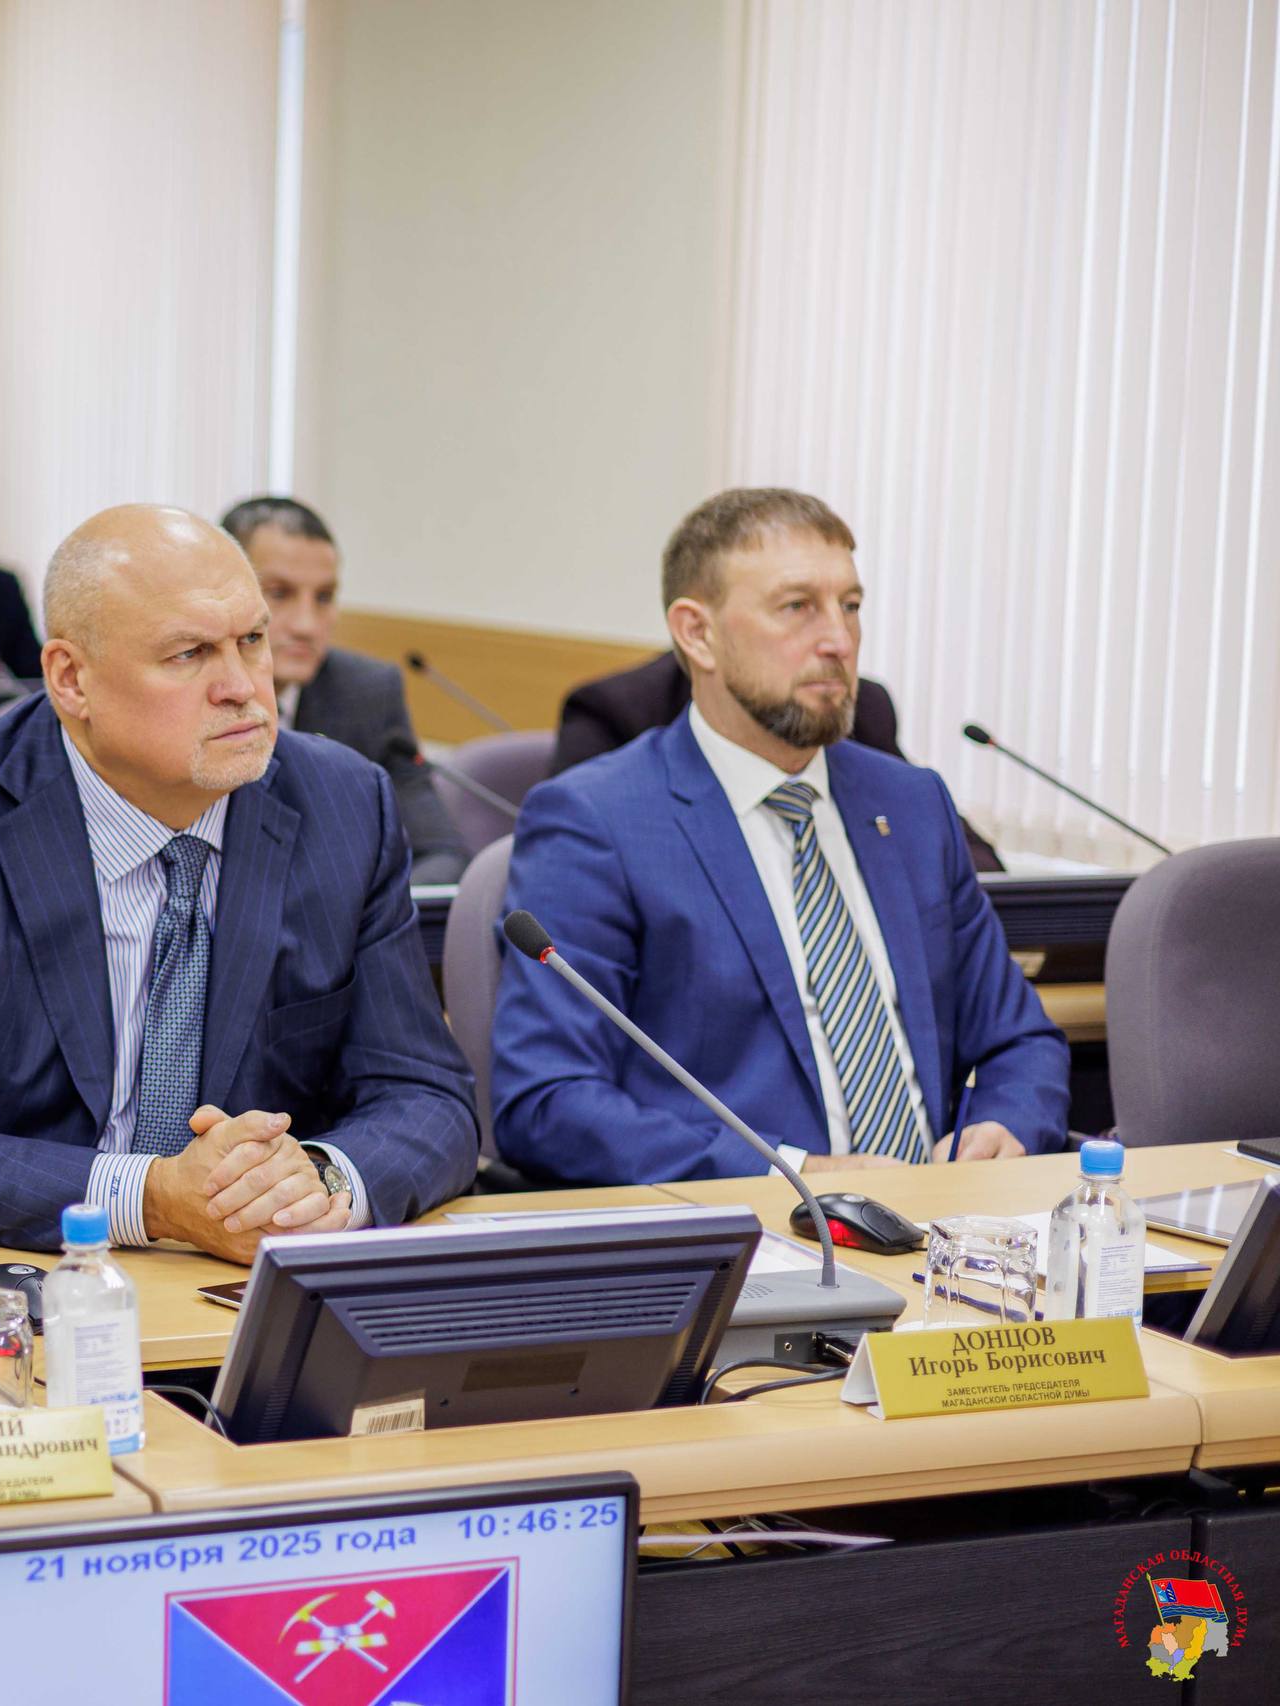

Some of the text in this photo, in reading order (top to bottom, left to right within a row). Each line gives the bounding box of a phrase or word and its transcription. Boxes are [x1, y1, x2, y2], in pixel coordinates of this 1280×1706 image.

[952, 1326, 1056, 1355] ДОНЦОВ
[909, 1347, 1107, 1378] Игорь Борисович
[946, 1379, 1081, 1397] ЗАМЕСТИТЕЛЬ ПРЕДСЕДАТЕЛЯ
[1009, 1390, 1062, 1403] ОБЛАСТНОЙ
[1064, 1388, 1090, 1400] ДУМЫ
[25, 1502, 618, 1582] 21 ноября 2025 года 10:46:25
